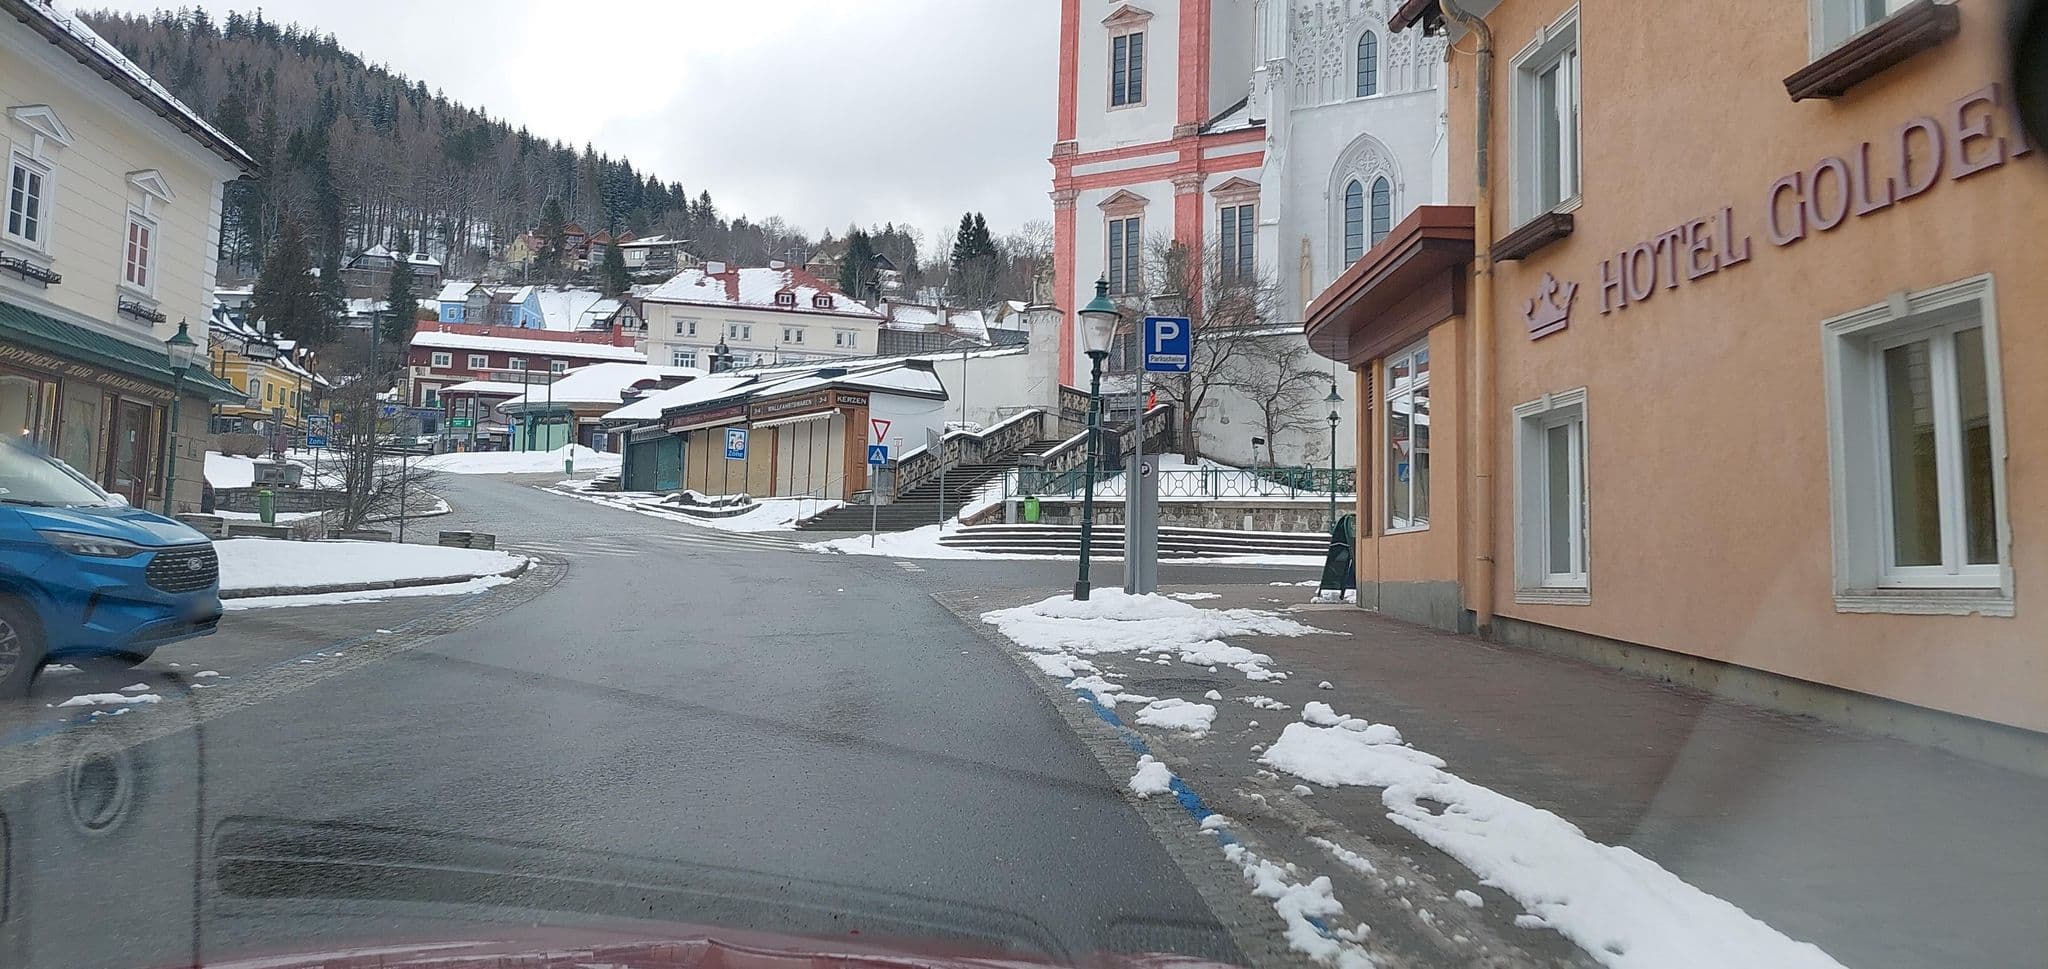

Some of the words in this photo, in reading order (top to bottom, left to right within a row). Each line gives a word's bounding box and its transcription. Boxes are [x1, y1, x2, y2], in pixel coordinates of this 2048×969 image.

[1599, 206, 1751, 315] HOTEL
[1155, 321, 1180, 352] P
[65, 365, 94, 378] ZUR
[837, 396, 867, 405] KERZEN
[727, 449, 744, 458] Zone
